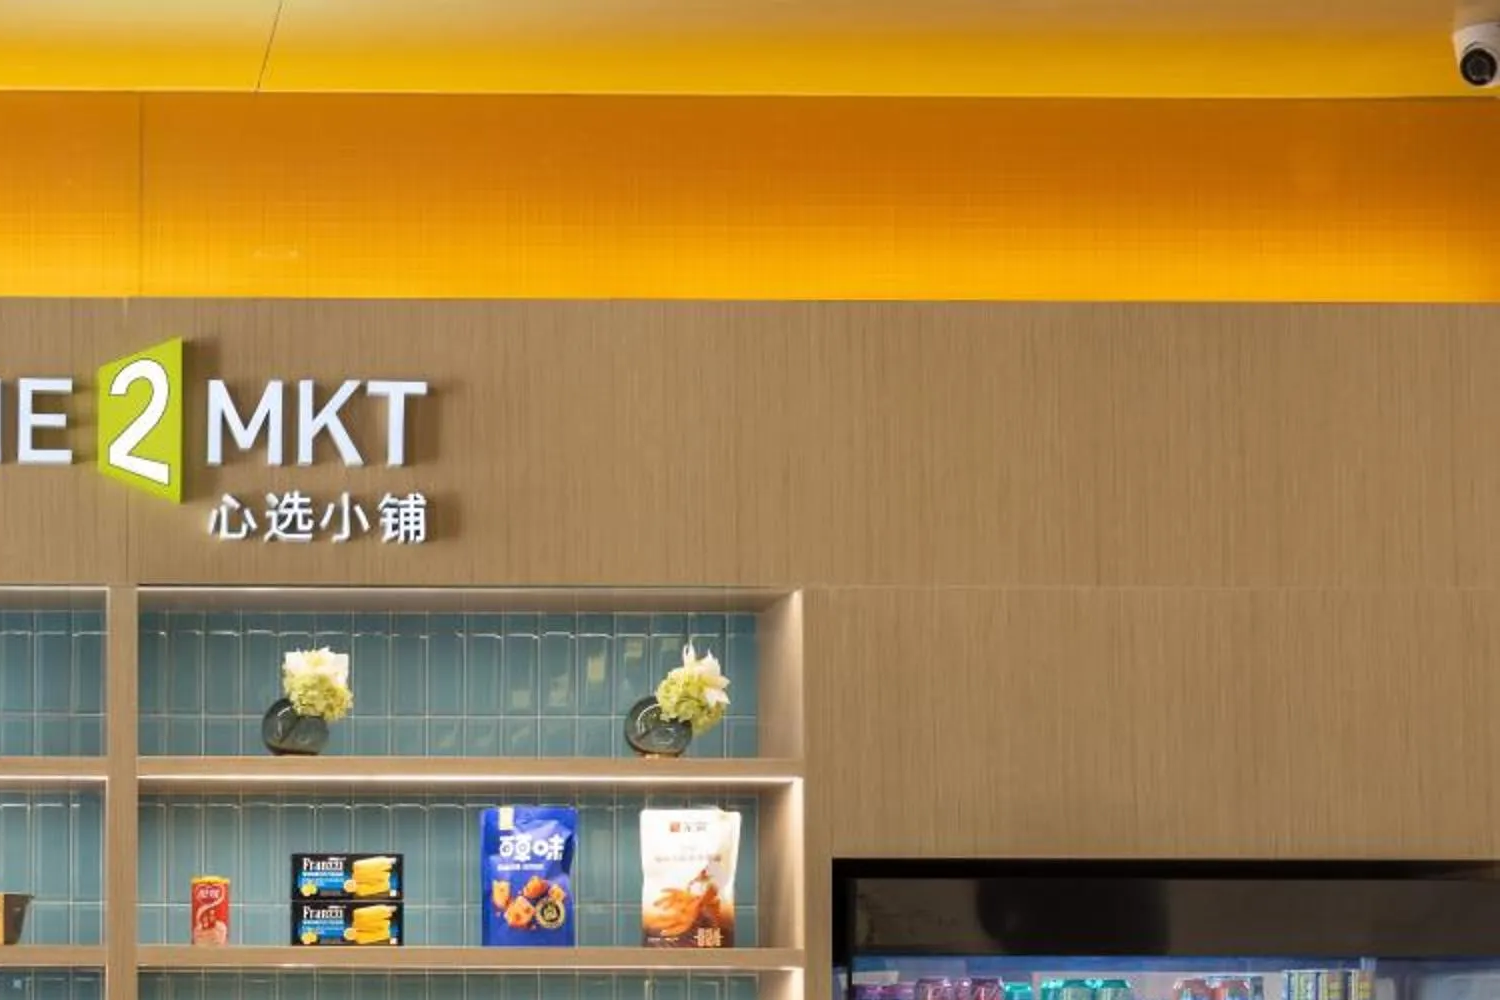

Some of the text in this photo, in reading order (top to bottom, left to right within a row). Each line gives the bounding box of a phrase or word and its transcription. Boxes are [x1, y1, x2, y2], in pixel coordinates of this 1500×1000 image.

[107, 357, 171, 487] 2
[206, 379, 428, 467] MKT
[209, 490, 428, 545] 心选小铺
